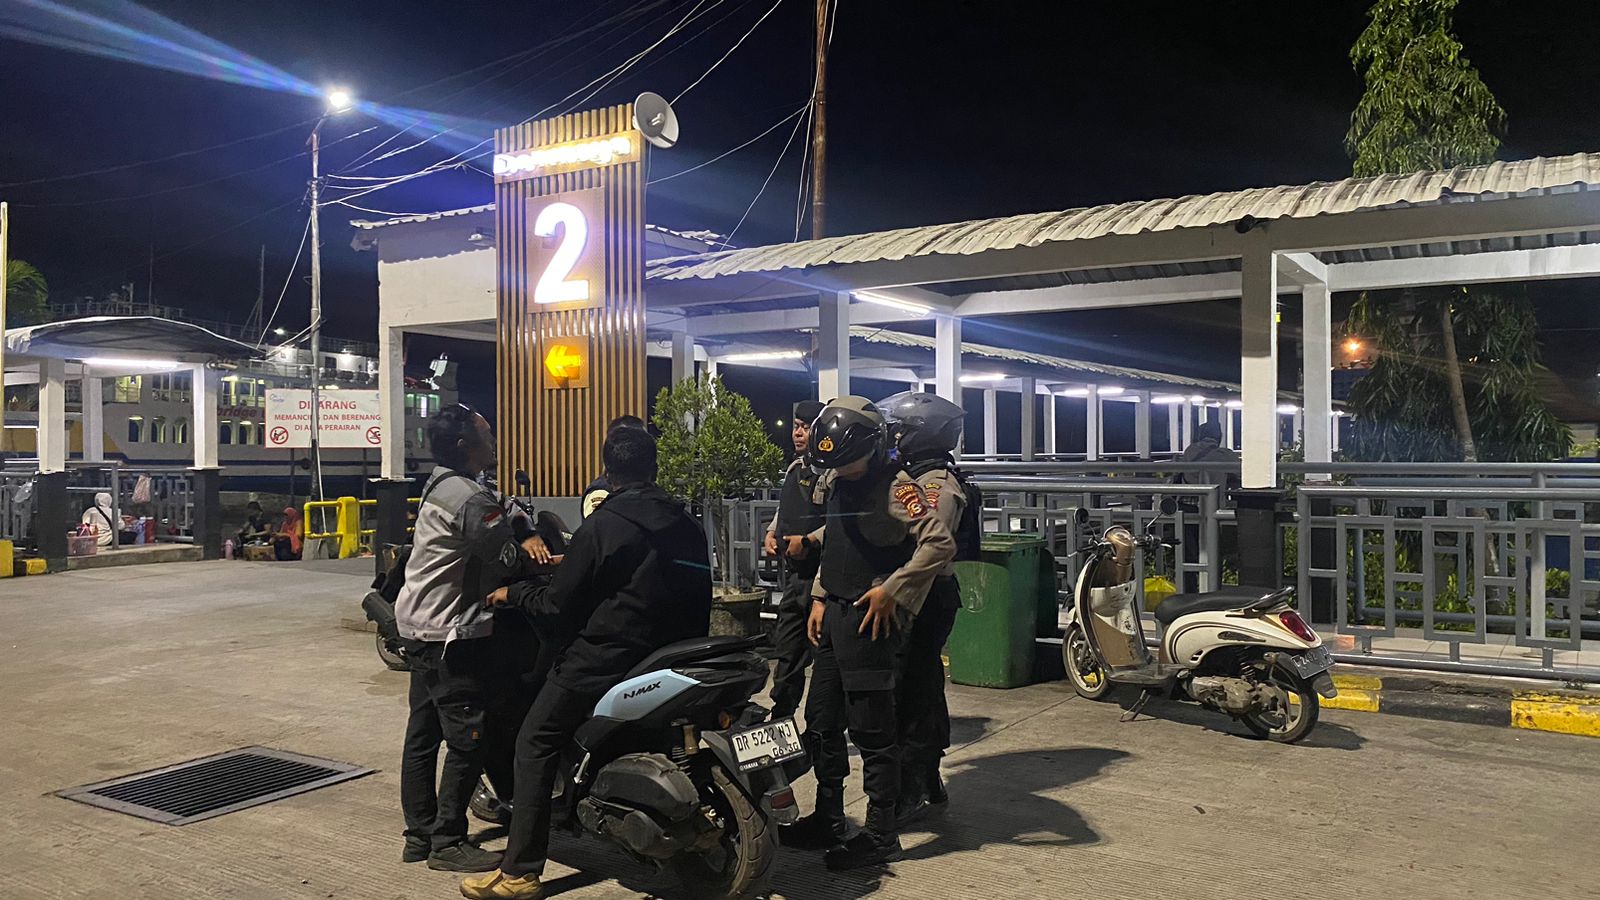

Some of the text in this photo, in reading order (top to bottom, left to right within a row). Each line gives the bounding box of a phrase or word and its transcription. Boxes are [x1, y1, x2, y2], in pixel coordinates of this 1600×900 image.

[534, 202, 589, 304] 2
[298, 400, 357, 410] DIARANG
[735, 735, 750, 752] DR
[751, 727, 777, 746] 5222
